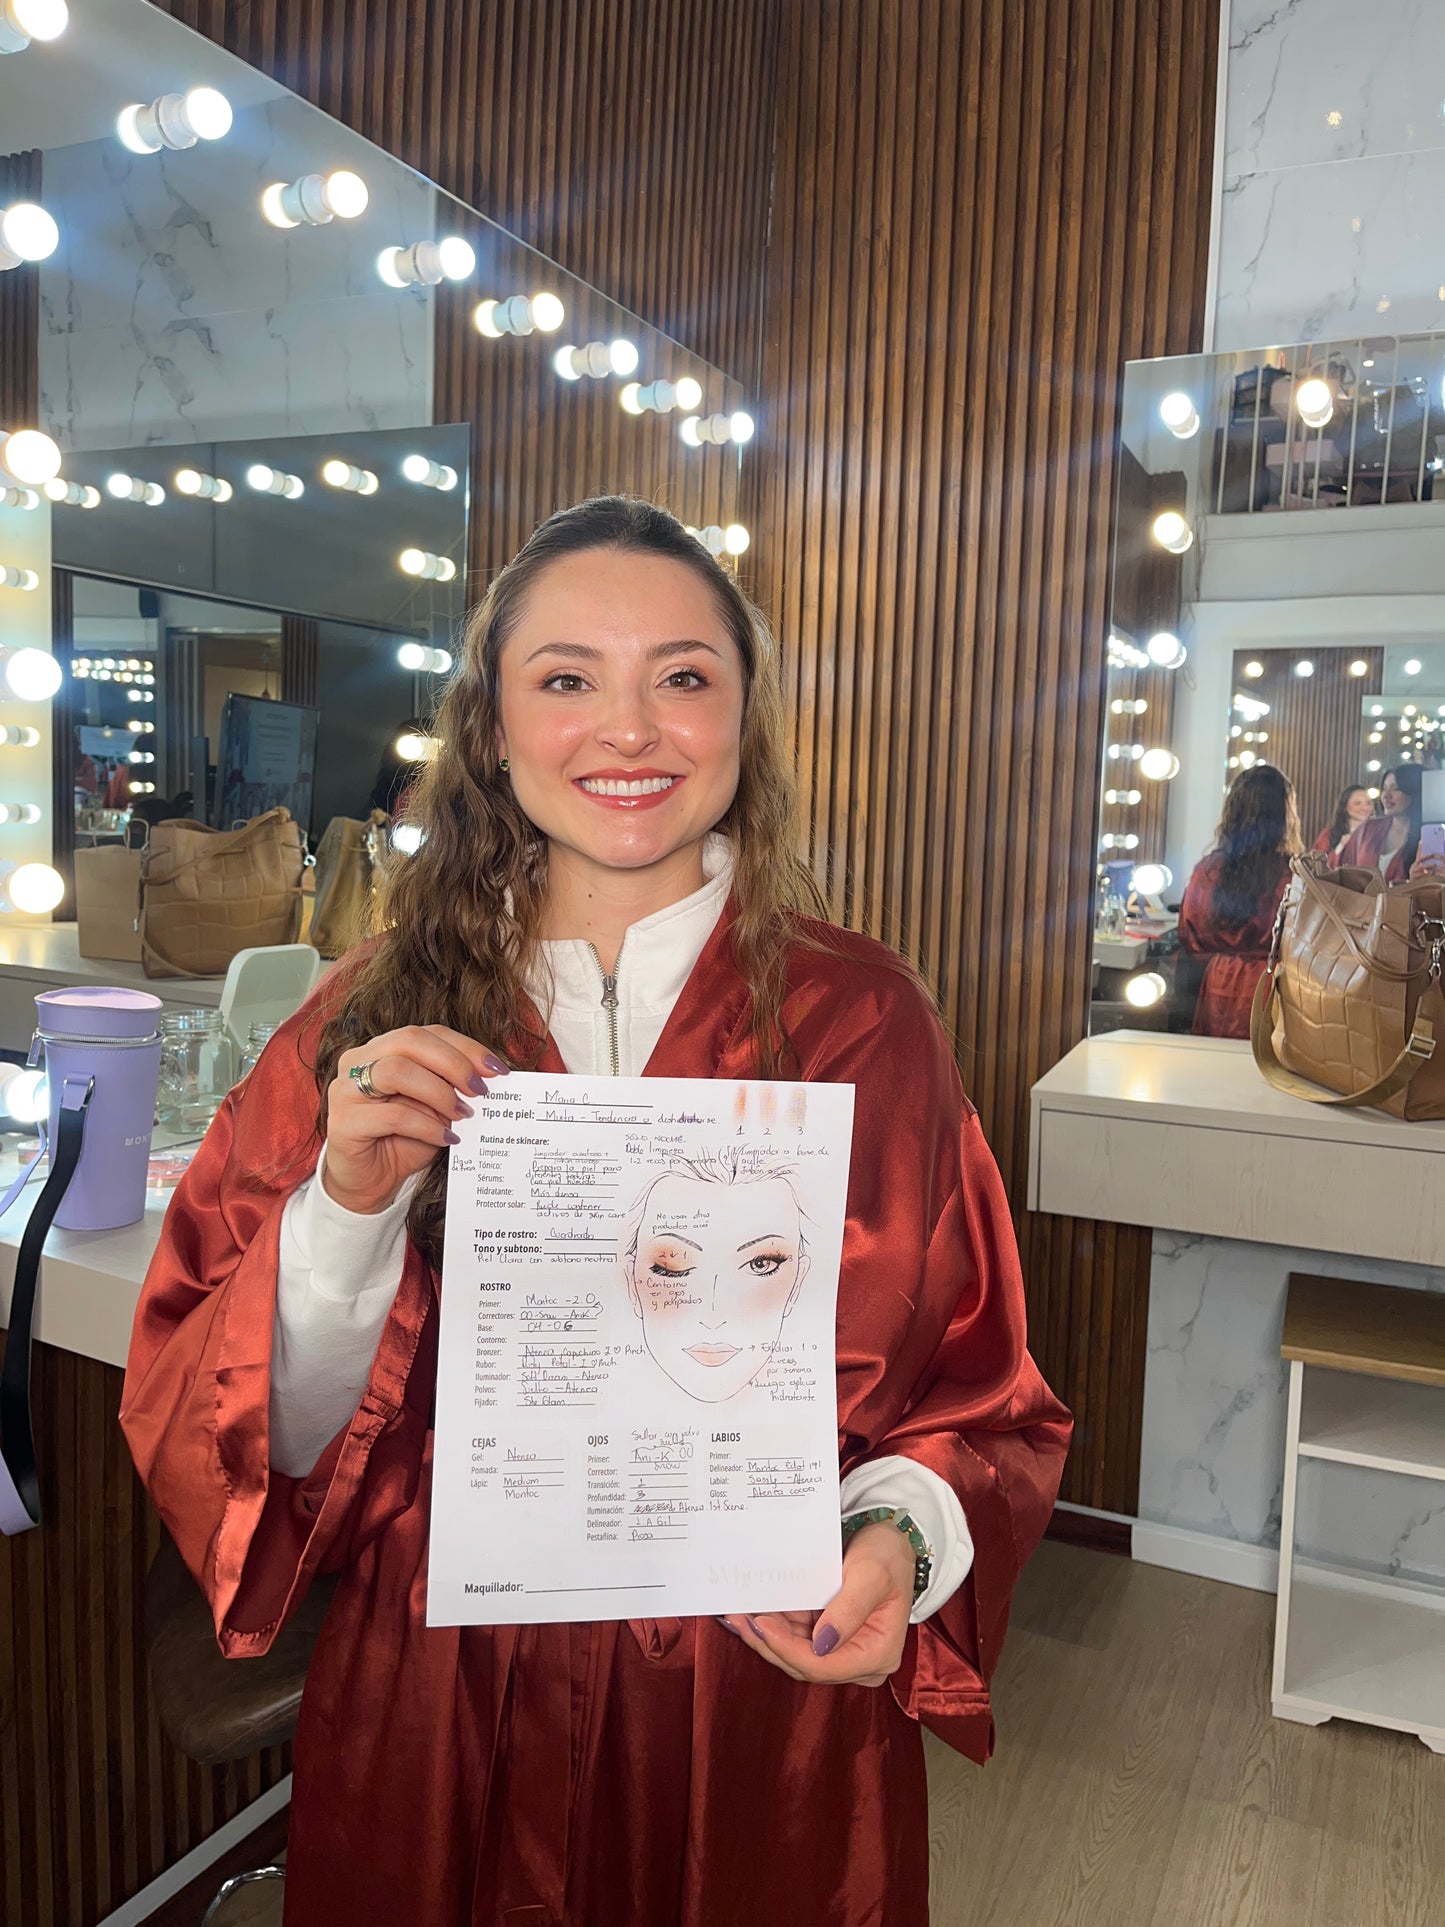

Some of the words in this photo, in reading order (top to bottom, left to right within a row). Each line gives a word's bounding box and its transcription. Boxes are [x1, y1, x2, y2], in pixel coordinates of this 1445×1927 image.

[483, 1090, 522, 1101] Nombre:
[482, 1108, 501, 1119] Tipo
[502, 1109, 514, 1119] de
[515, 1109, 535, 1120] piel:
[736, 1125, 745, 1135] 1
[763, 1127, 772, 1135] 2
[797, 1126, 804, 1135] 3
[480, 1135, 504, 1144] Rutina
[505, 1136, 515, 1144] de
[516, 1136, 550, 1146] skincare:
[480, 1147, 510, 1158] Limpieza:
[478, 1160, 502, 1170] Tónico:
[477, 1173, 504, 1183] Sérums:
[477, 1186, 514, 1196] Hidratante:
[476, 1199, 506, 1208] Protector
[507, 1200, 526, 1209] solar:
[474, 1229, 494, 1240] Tipo
[495, 1229, 506, 1239] de
[508, 1230, 538, 1239] rostro:
[473, 1244, 495, 1253] Tono
[497, 1246, 503, 1255] y
[504, 1244, 543, 1254] subtono:
[480, 1282, 512, 1292] ROSTRO
[478, 1300, 502, 1308] Primer:
[478, 1312, 516, 1320] Correctores:
[477, 1324, 494, 1332] Base:
[477, 1336, 508, 1344] Contorno:
[476, 1348, 502, 1356] Bronzer:
[475, 1361, 497, 1369] Rubor:
[475, 1373, 512, 1381] Iluminador:
[474, 1386, 497, 1394] Polvos:
[474, 1398, 498, 1407] Fijador:
[587, 1435, 609, 1447] OJOS
[711, 1432, 741, 1442] LABIOS
[472, 1437, 497, 1450] CEJAS
[471, 1453, 485, 1462] Gel:
[587, 1455, 610, 1463] Primer:
[709, 1452, 731, 1460] Primer:
[471, 1466, 499, 1475] Pomada:
[587, 1468, 618, 1476] Corrector:
[709, 1464, 744, 1472] Delineador:
[470, 1479, 489, 1490] Lápiz:
[587, 1480, 620, 1489] Transición:
[709, 1476, 729, 1485] Labial:
[587, 1493, 627, 1502] Profundidad:
[709, 1489, 728, 1498] Gloss:
[586, 1506, 625, 1515] Iluminación:
[586, 1519, 623, 1528] Delineador:
[586, 1532, 619, 1541] Pestañina:
[464, 1582, 524, 1596] Maquillador:
